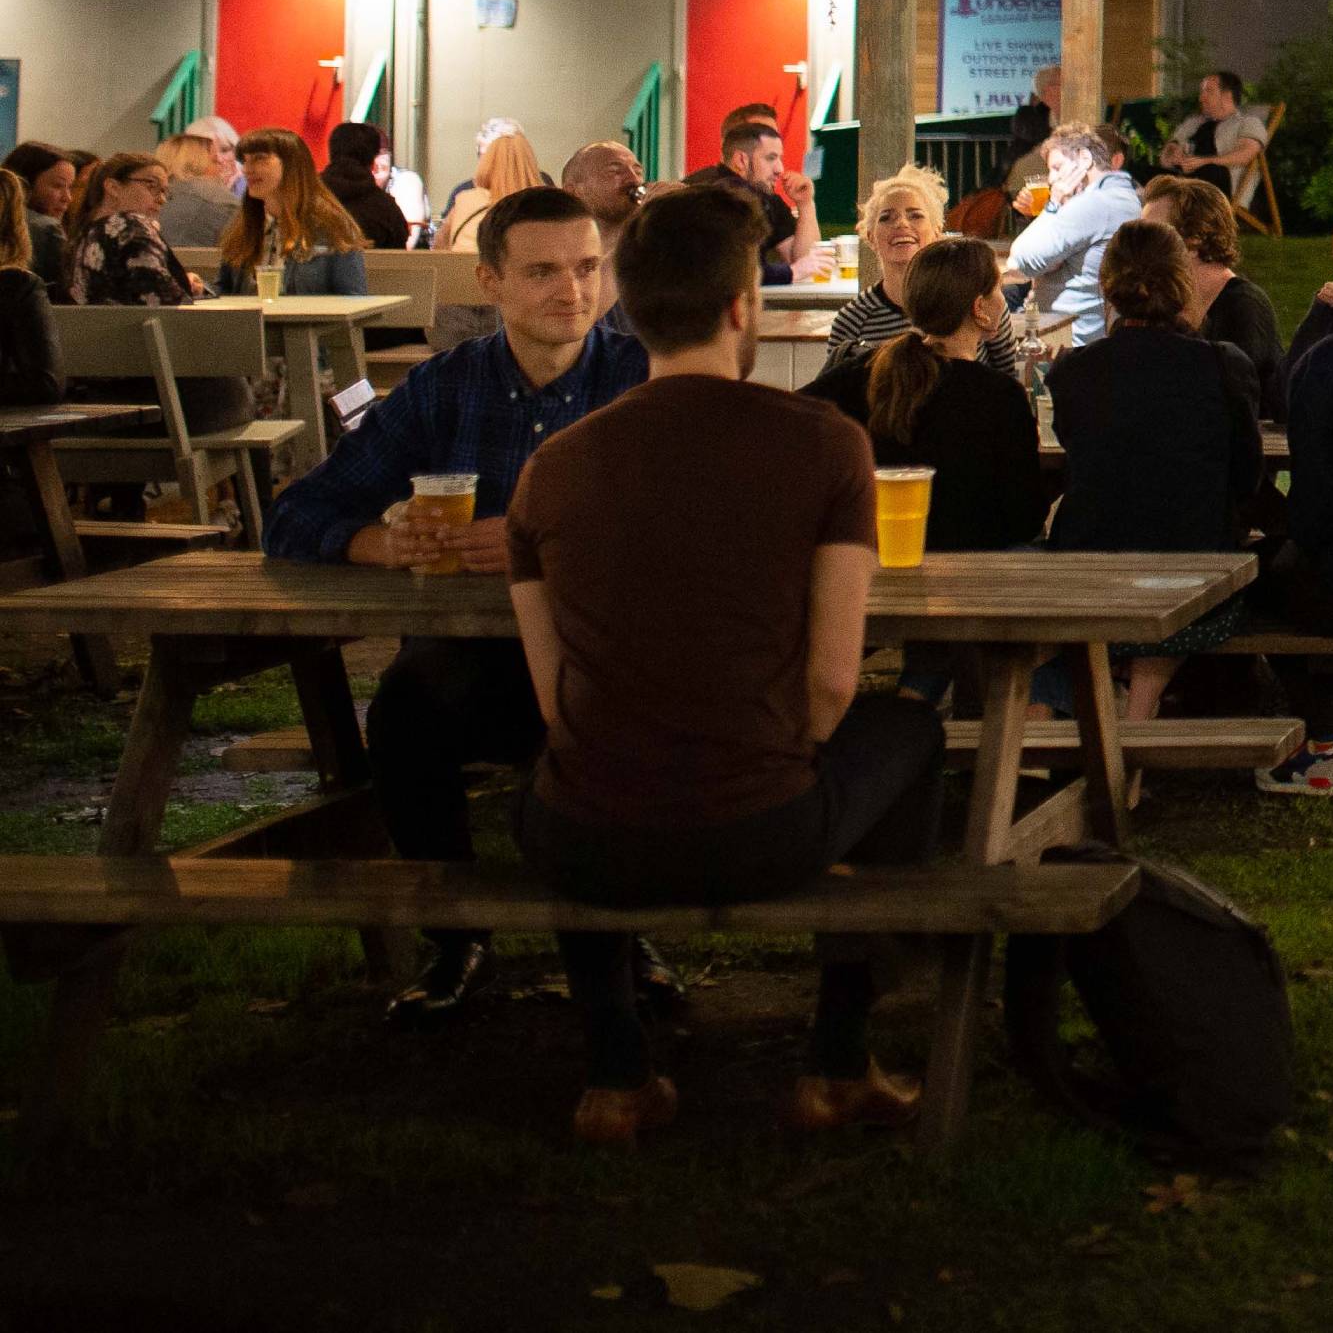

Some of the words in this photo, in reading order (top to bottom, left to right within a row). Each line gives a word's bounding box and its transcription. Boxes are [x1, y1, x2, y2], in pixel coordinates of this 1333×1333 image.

[974, 40, 1002, 52] LIVE
[962, 54, 1028, 65] OUTDOOR
[969, 68, 1017, 78] STREET
[987, 93, 1025, 106] JULY
